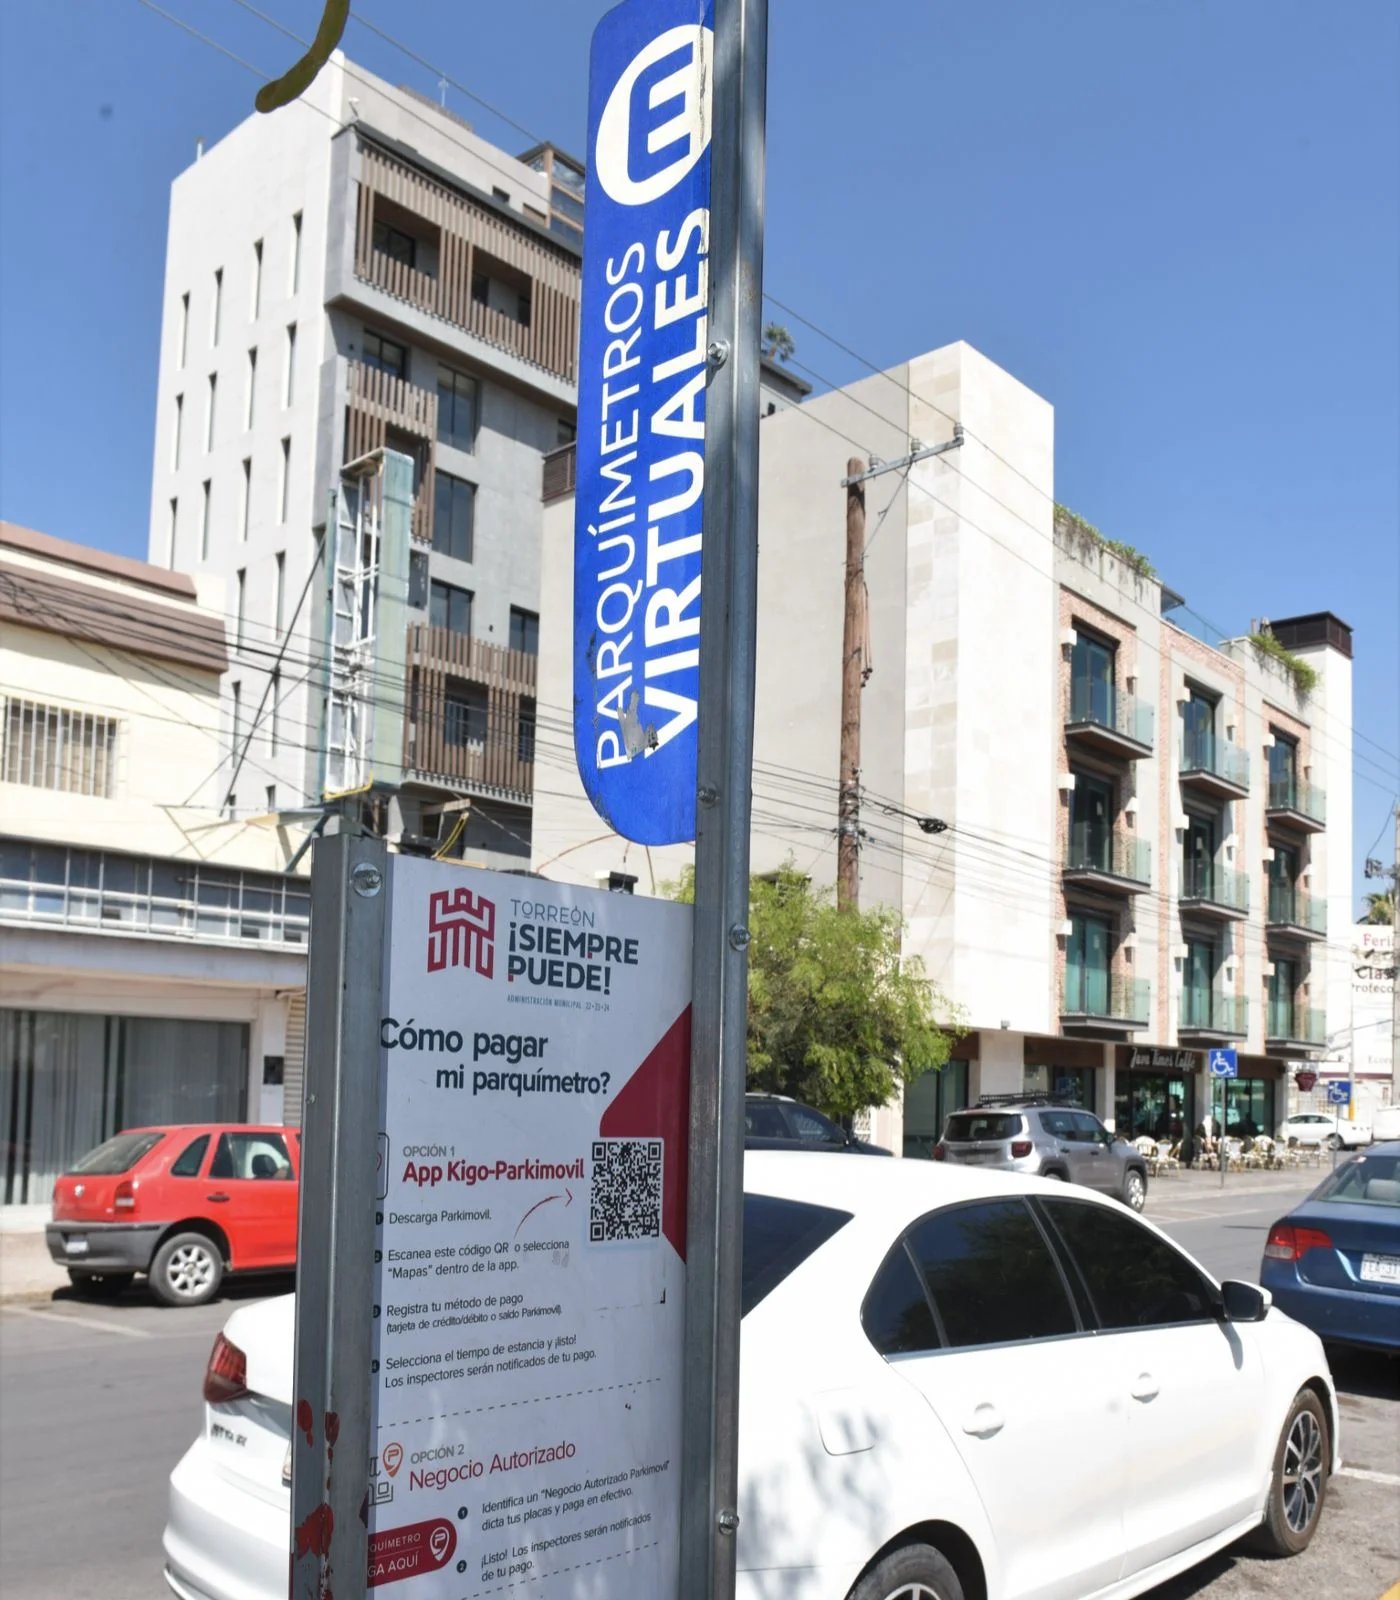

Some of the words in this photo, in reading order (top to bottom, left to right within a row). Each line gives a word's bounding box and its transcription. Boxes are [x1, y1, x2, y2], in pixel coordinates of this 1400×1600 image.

[644, 207, 709, 759] VIRTUALES
[588, 241, 645, 769] PARQUÍMETROS
[511, 899, 595, 928] TORREÓN
[509, 922, 639, 965] ¡SIEMPRE
[508, 954, 611, 995] PUEDE!
[379, 1017, 463, 1053] Cómo
[473, 1031, 548, 1064] pagar
[436, 1064, 464, 1089] mi
[473, 1067, 611, 1097] parquímetro?
[402, 1143, 447, 1158] OPCIÓN
[450, 1146, 456, 1156] 1
[402, 1161, 443, 1187] App
[447, 1158, 585, 1186] Kigo-Parkimovil
[389, 1212, 437, 1226] Descarga
[441, 1209, 492, 1222] Parkimovil.
[388, 1249, 431, 1262] Escanea
[434, 1246, 456, 1258] este
[458, 1243, 491, 1258] código
[493, 1242, 509, 1255] QR
[514, 1244, 521, 1253] o
[523, 1239, 570, 1252] selecciona
[435, 1263, 469, 1276] dentro
[472, 1261, 485, 1273] de
[487, 1260, 496, 1271] la
[498, 1259, 519, 1272] app.
[387, 1302, 429, 1318] Registra
[431, 1301, 441, 1312] tu
[444, 1296, 482, 1311] método
[484, 1295, 498, 1307] de
[499, 1293, 524, 1308] pago
[386, 1320, 416, 1335] (tarjeta
[418, 1318, 430, 1330] de
[432, 1311, 489, 1328] crédito/débito
[490, 1313, 497, 1321] o
[498, 1309, 520, 1321] saldo
[386, 1353, 442, 1370] Selecciona
[444, 1350, 454, 1362] el
[456, 1345, 490, 1361] tiempo
[492, 1343, 505, 1355] de
[507, 1337, 545, 1353] estancia
[546, 1339, 553, 1351] y
[554, 1333, 577, 1350] ¡listo!
[385, 1375, 404, 1389] Los
[406, 1367, 465, 1387] inspectores
[467, 1361, 494, 1376] serán
[496, 1354, 546, 1372] notificados
[548, 1350, 560, 1363] de
[562, 1349, 571, 1361] tu
[573, 1347, 597, 1363] pago.
[409, 1459, 484, 1491] Negocio
[489, 1440, 576, 1475] Autorizado
[410, 1446, 455, 1465] OPCIÓN
[457, 1443, 465, 1455] 2
[482, 1494, 525, 1514] Identifica
[526, 1492, 539, 1503] un
[583, 1471, 629, 1490] Autorizado
[481, 1517, 505, 1531] dicta
[507, 1512, 521, 1525] tus
[523, 1506, 553, 1524] placas
[554, 1505, 561, 1516] y
[562, 1498, 585, 1514] paga
[586, 1494, 599, 1506] en
[367, 1532, 421, 1553] QUÍMETRO
[480, 1548, 508, 1568] ¡Listo!
[512, 1544, 529, 1558] Los
[531, 1533, 582, 1553] inspectores
[584, 1523, 608, 1539] serán
[610, 1511, 653, 1532] notificados
[388, 1551, 420, 1573] AQUÍ
[481, 1567, 495, 1582] de
[496, 1567, 507, 1579] tu
[508, 1559, 535, 1577] pago.
